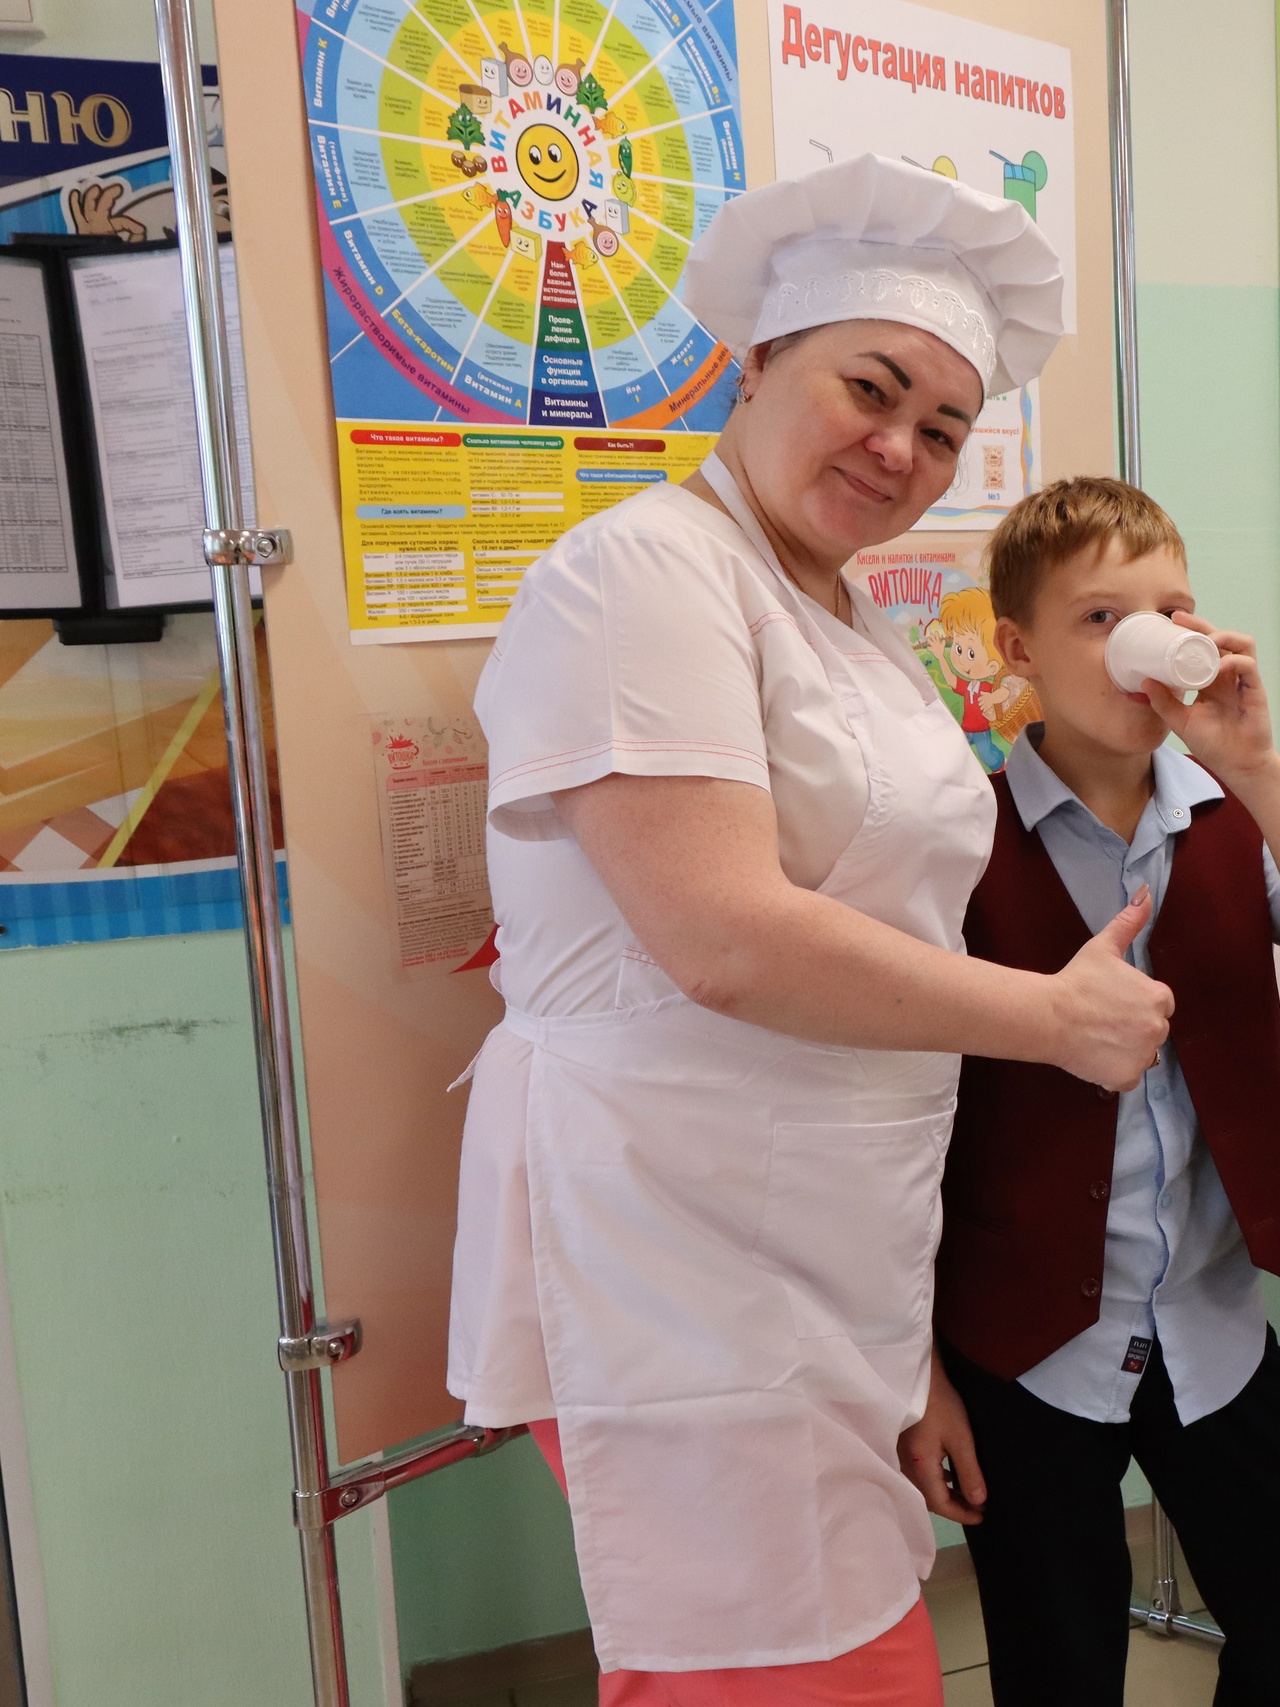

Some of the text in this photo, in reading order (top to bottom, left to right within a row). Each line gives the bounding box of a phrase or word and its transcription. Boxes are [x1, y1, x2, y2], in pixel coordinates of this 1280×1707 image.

[702, 25, 732, 82] витамины
[782, 4, 1066, 119] Дегустация напитков
[314, 51, 326, 107] Витамин
[723, 121, 738, 170] Витамин
[317, 135, 336, 196] Витамин
[343, 229, 376, 285] Витамин
[548, 315, 574, 325] Прояв-
[551, 326, 572, 334] ление
[333, 266, 416, 374] Жирорастворимые
[417, 373, 470, 414] витамины
[391, 308, 454, 373] Бета-каротин
[544, 335, 580, 344] дефицита
[543, 356, 583, 366] Основные
[547, 367, 581, 376] функции
[464, 375, 512, 405] Витамин
[548, 378, 588, 387] организме
[669, 362, 719, 413] Минеральные
[544, 397, 588, 408] Витамины
[549, 410, 593, 420] минералы
[857, 552, 879, 565] Кисели
[868, 567, 942, 613] ВИТОШКА
